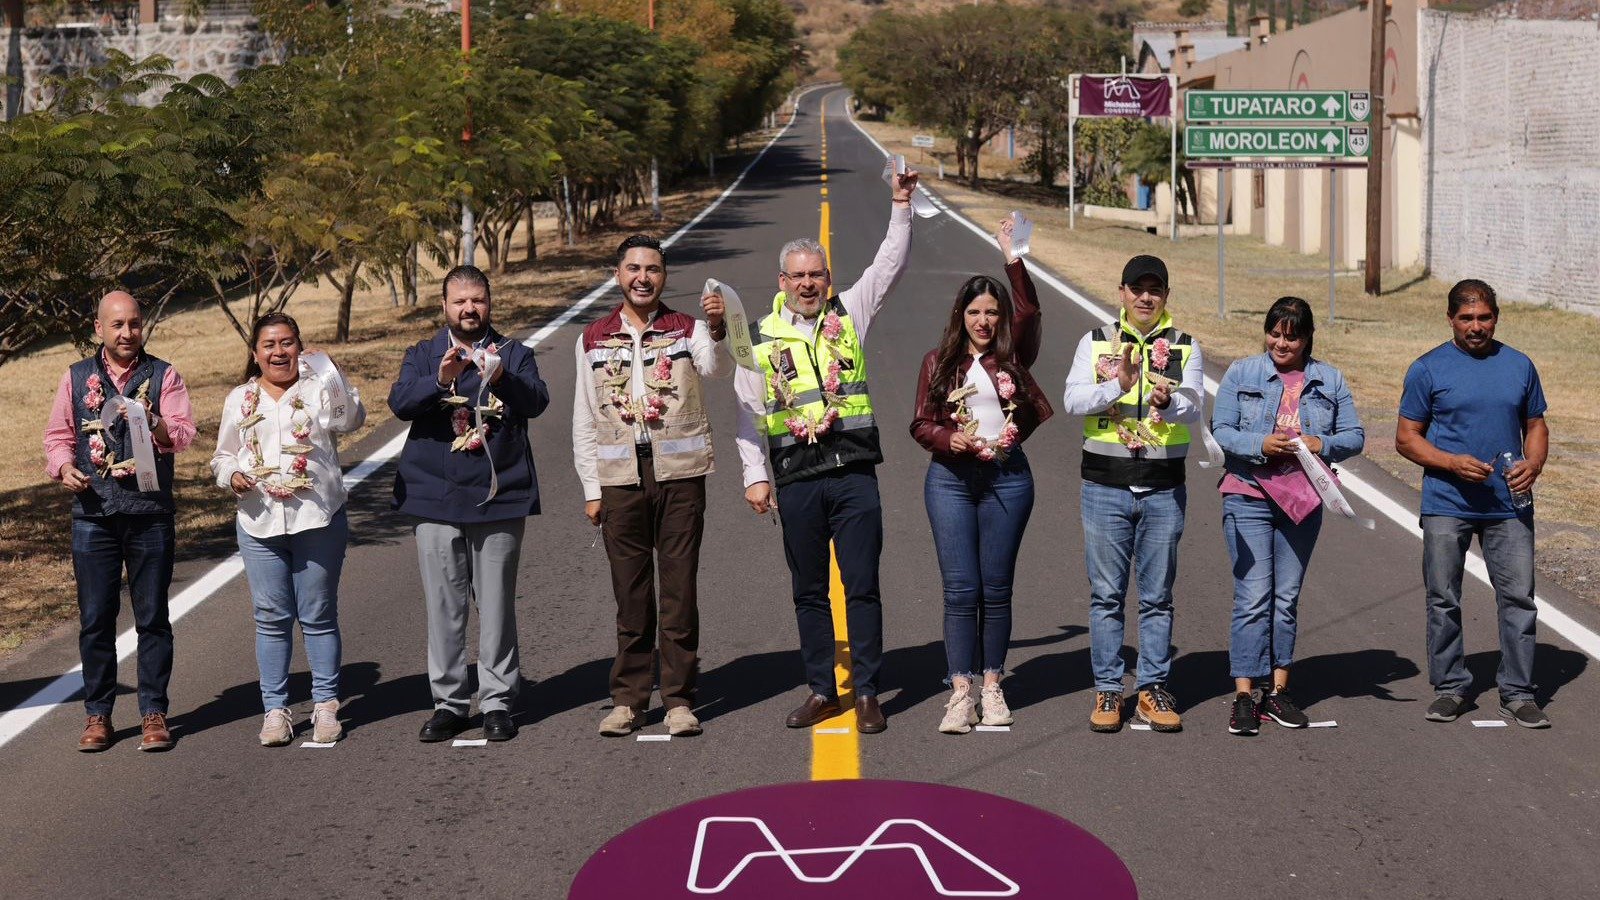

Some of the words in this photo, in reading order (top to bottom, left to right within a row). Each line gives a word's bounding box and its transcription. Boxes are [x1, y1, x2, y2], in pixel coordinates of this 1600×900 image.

[1209, 97, 1317, 115] TUPATARO
[1352, 101, 1366, 110] 43
[1209, 132, 1318, 150] MOROLEON
[1351, 137, 1365, 146] 43
